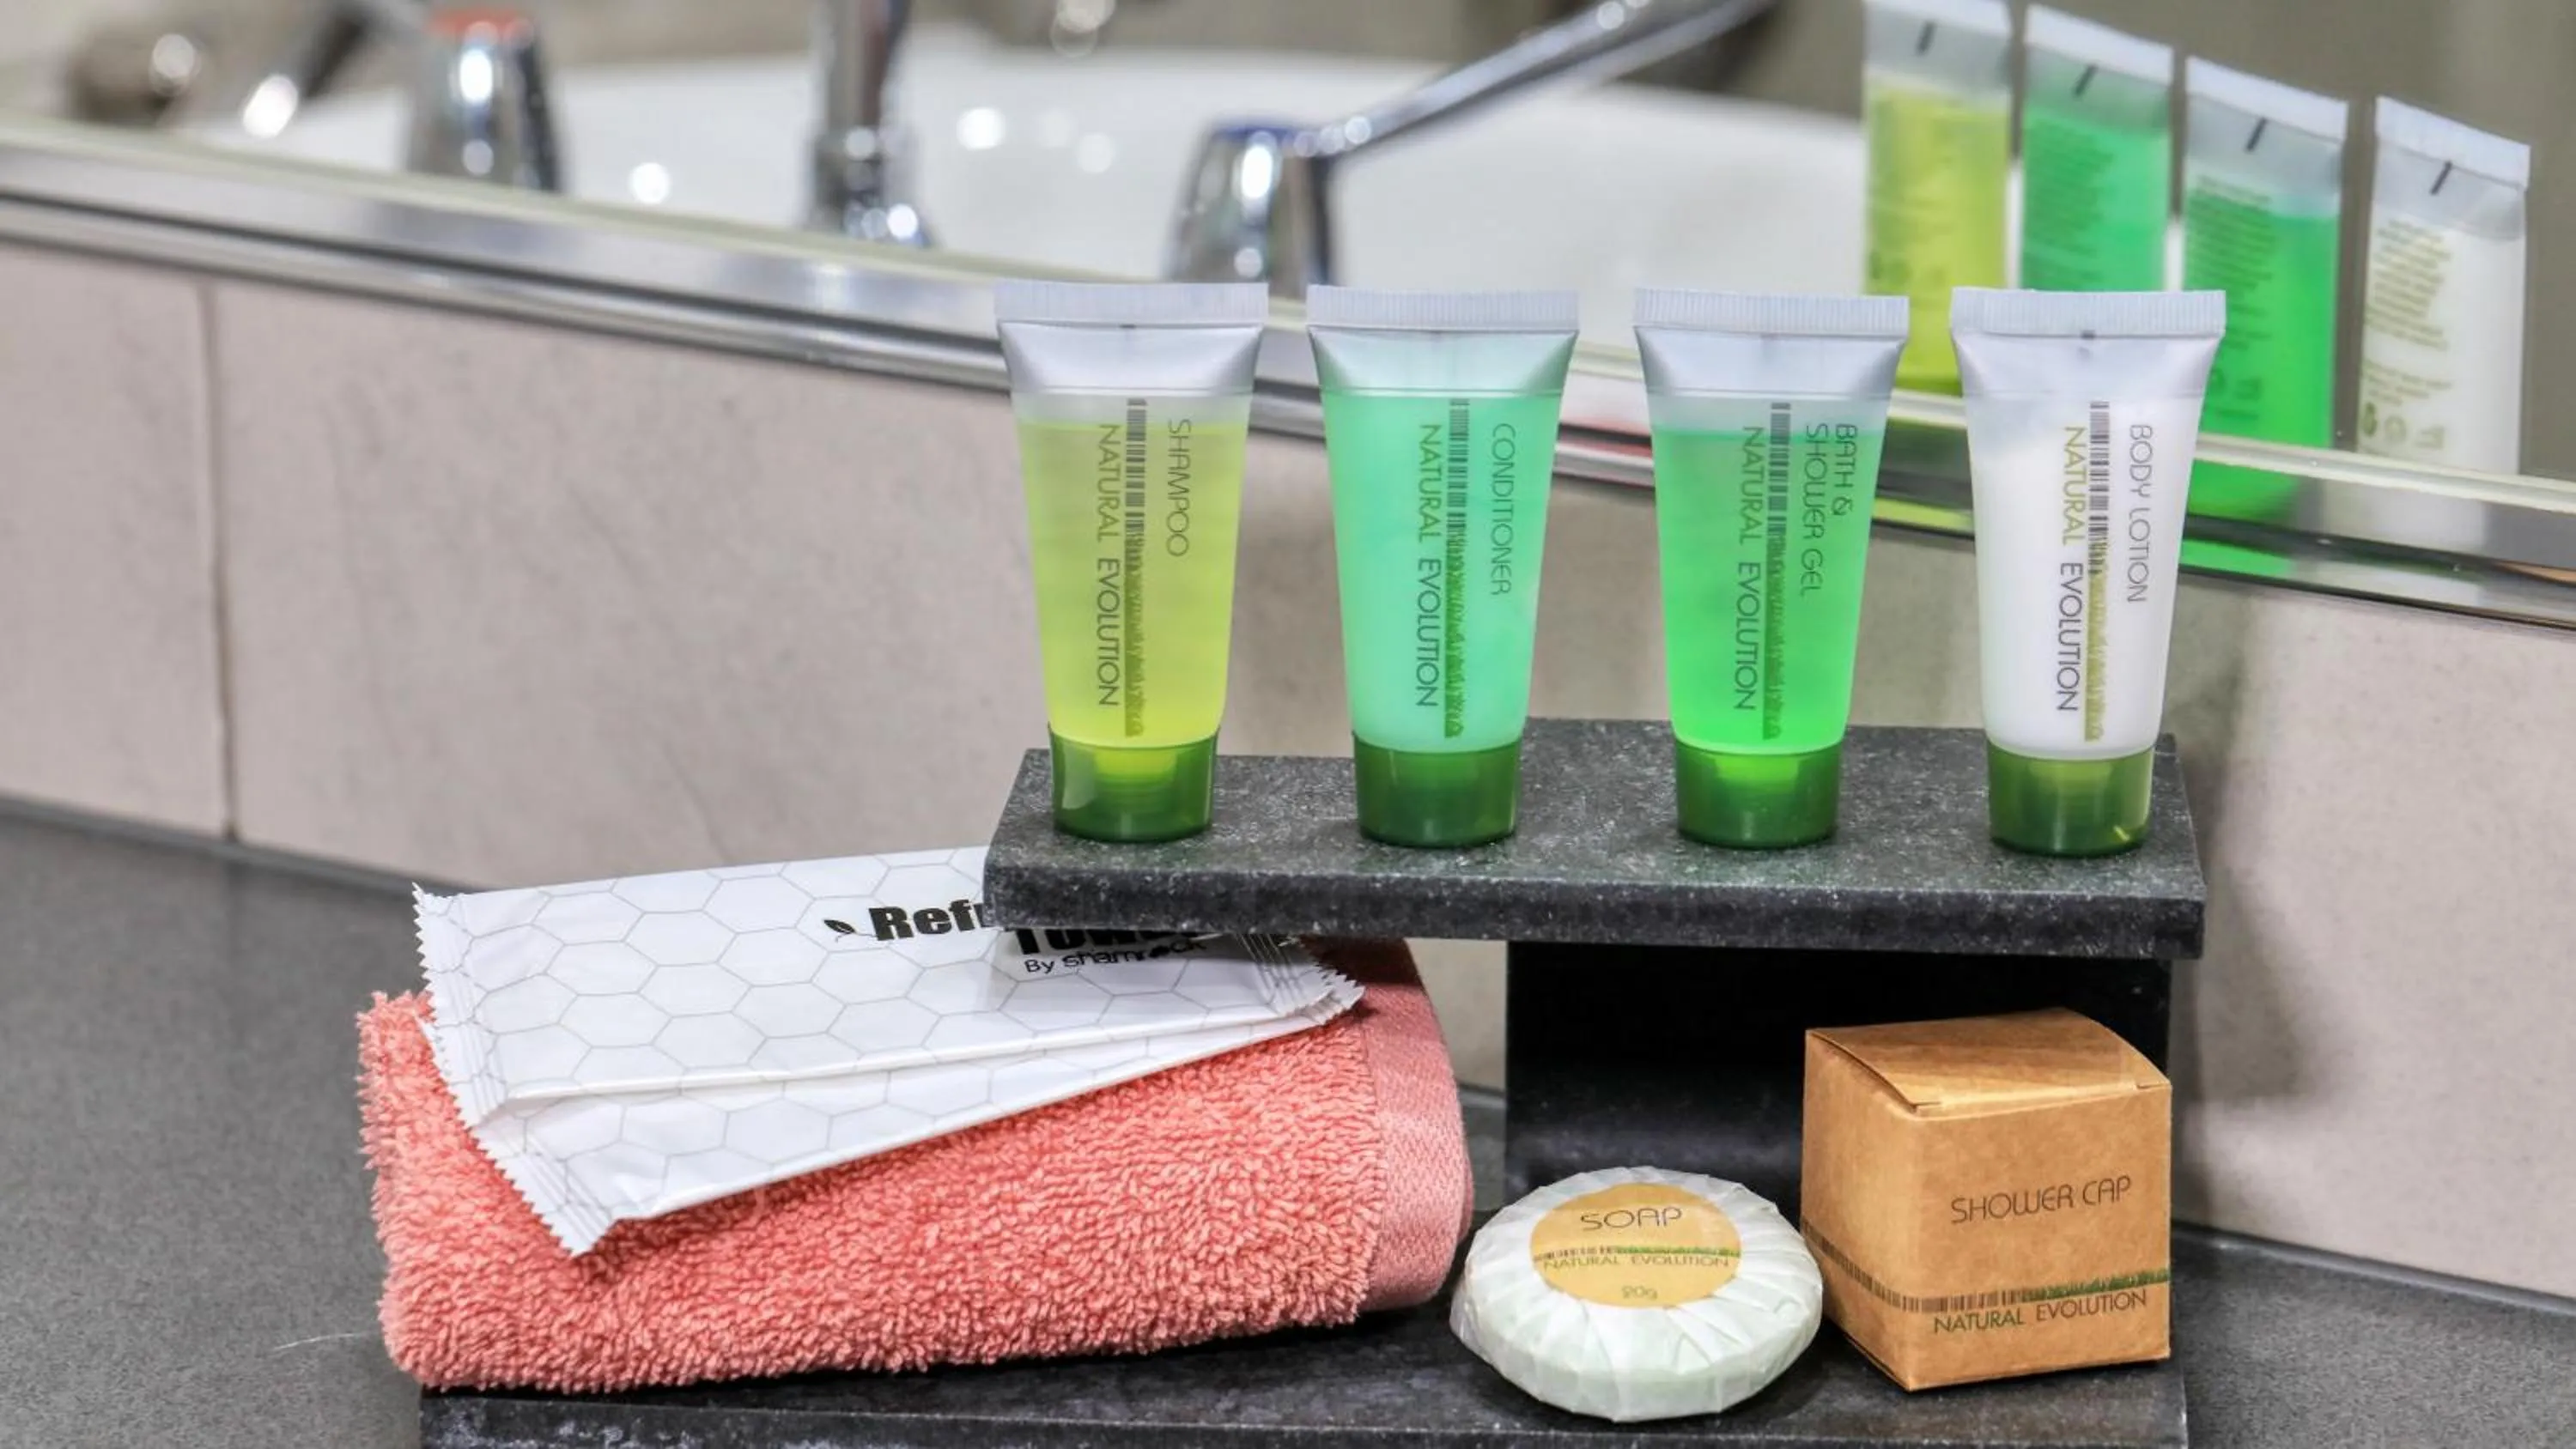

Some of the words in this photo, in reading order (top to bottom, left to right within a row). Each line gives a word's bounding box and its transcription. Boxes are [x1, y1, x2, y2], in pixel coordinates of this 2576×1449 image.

[1097, 424, 1121, 543] NATURAL
[1166, 418, 1192, 557] SHAMPOO
[1419, 424, 1443, 543] NATURAL
[1491, 422, 1516, 597] CONDITIONER
[1740, 426, 1765, 545] NATURAL
[1802, 422, 1829, 540] SHOWER
[1832, 496, 1854, 516] &
[1834, 424, 1857, 488] BATH
[2063, 426, 2087, 546] NATURAL
[2129, 424, 2153, 499] BODY
[1801, 548, 1824, 597] GEL
[2127, 507, 2151, 603] LOTION
[1097, 557, 1121, 706] EVOLUTION
[1416, 559, 1442, 707] EVOLUTION
[1734, 562, 1761, 711] EVOLUTION
[2057, 562, 2083, 712] EVOLUTION
[1016, 929, 1200, 955] Tow
[1024, 959, 1054, 974] By
[1581, 1207, 1682, 1231] SOAP
[1951, 1184, 2073, 1224] SHOWER
[2082, 1175, 2131, 1206] CAP
[1543, 1256, 1619, 1270] NATURAL
[1631, 1255, 1729, 1268] EVOLUTION
[1934, 1310, 2026, 1334] NATURAL
[2036, 1289, 2148, 1321] EVOLUTION
